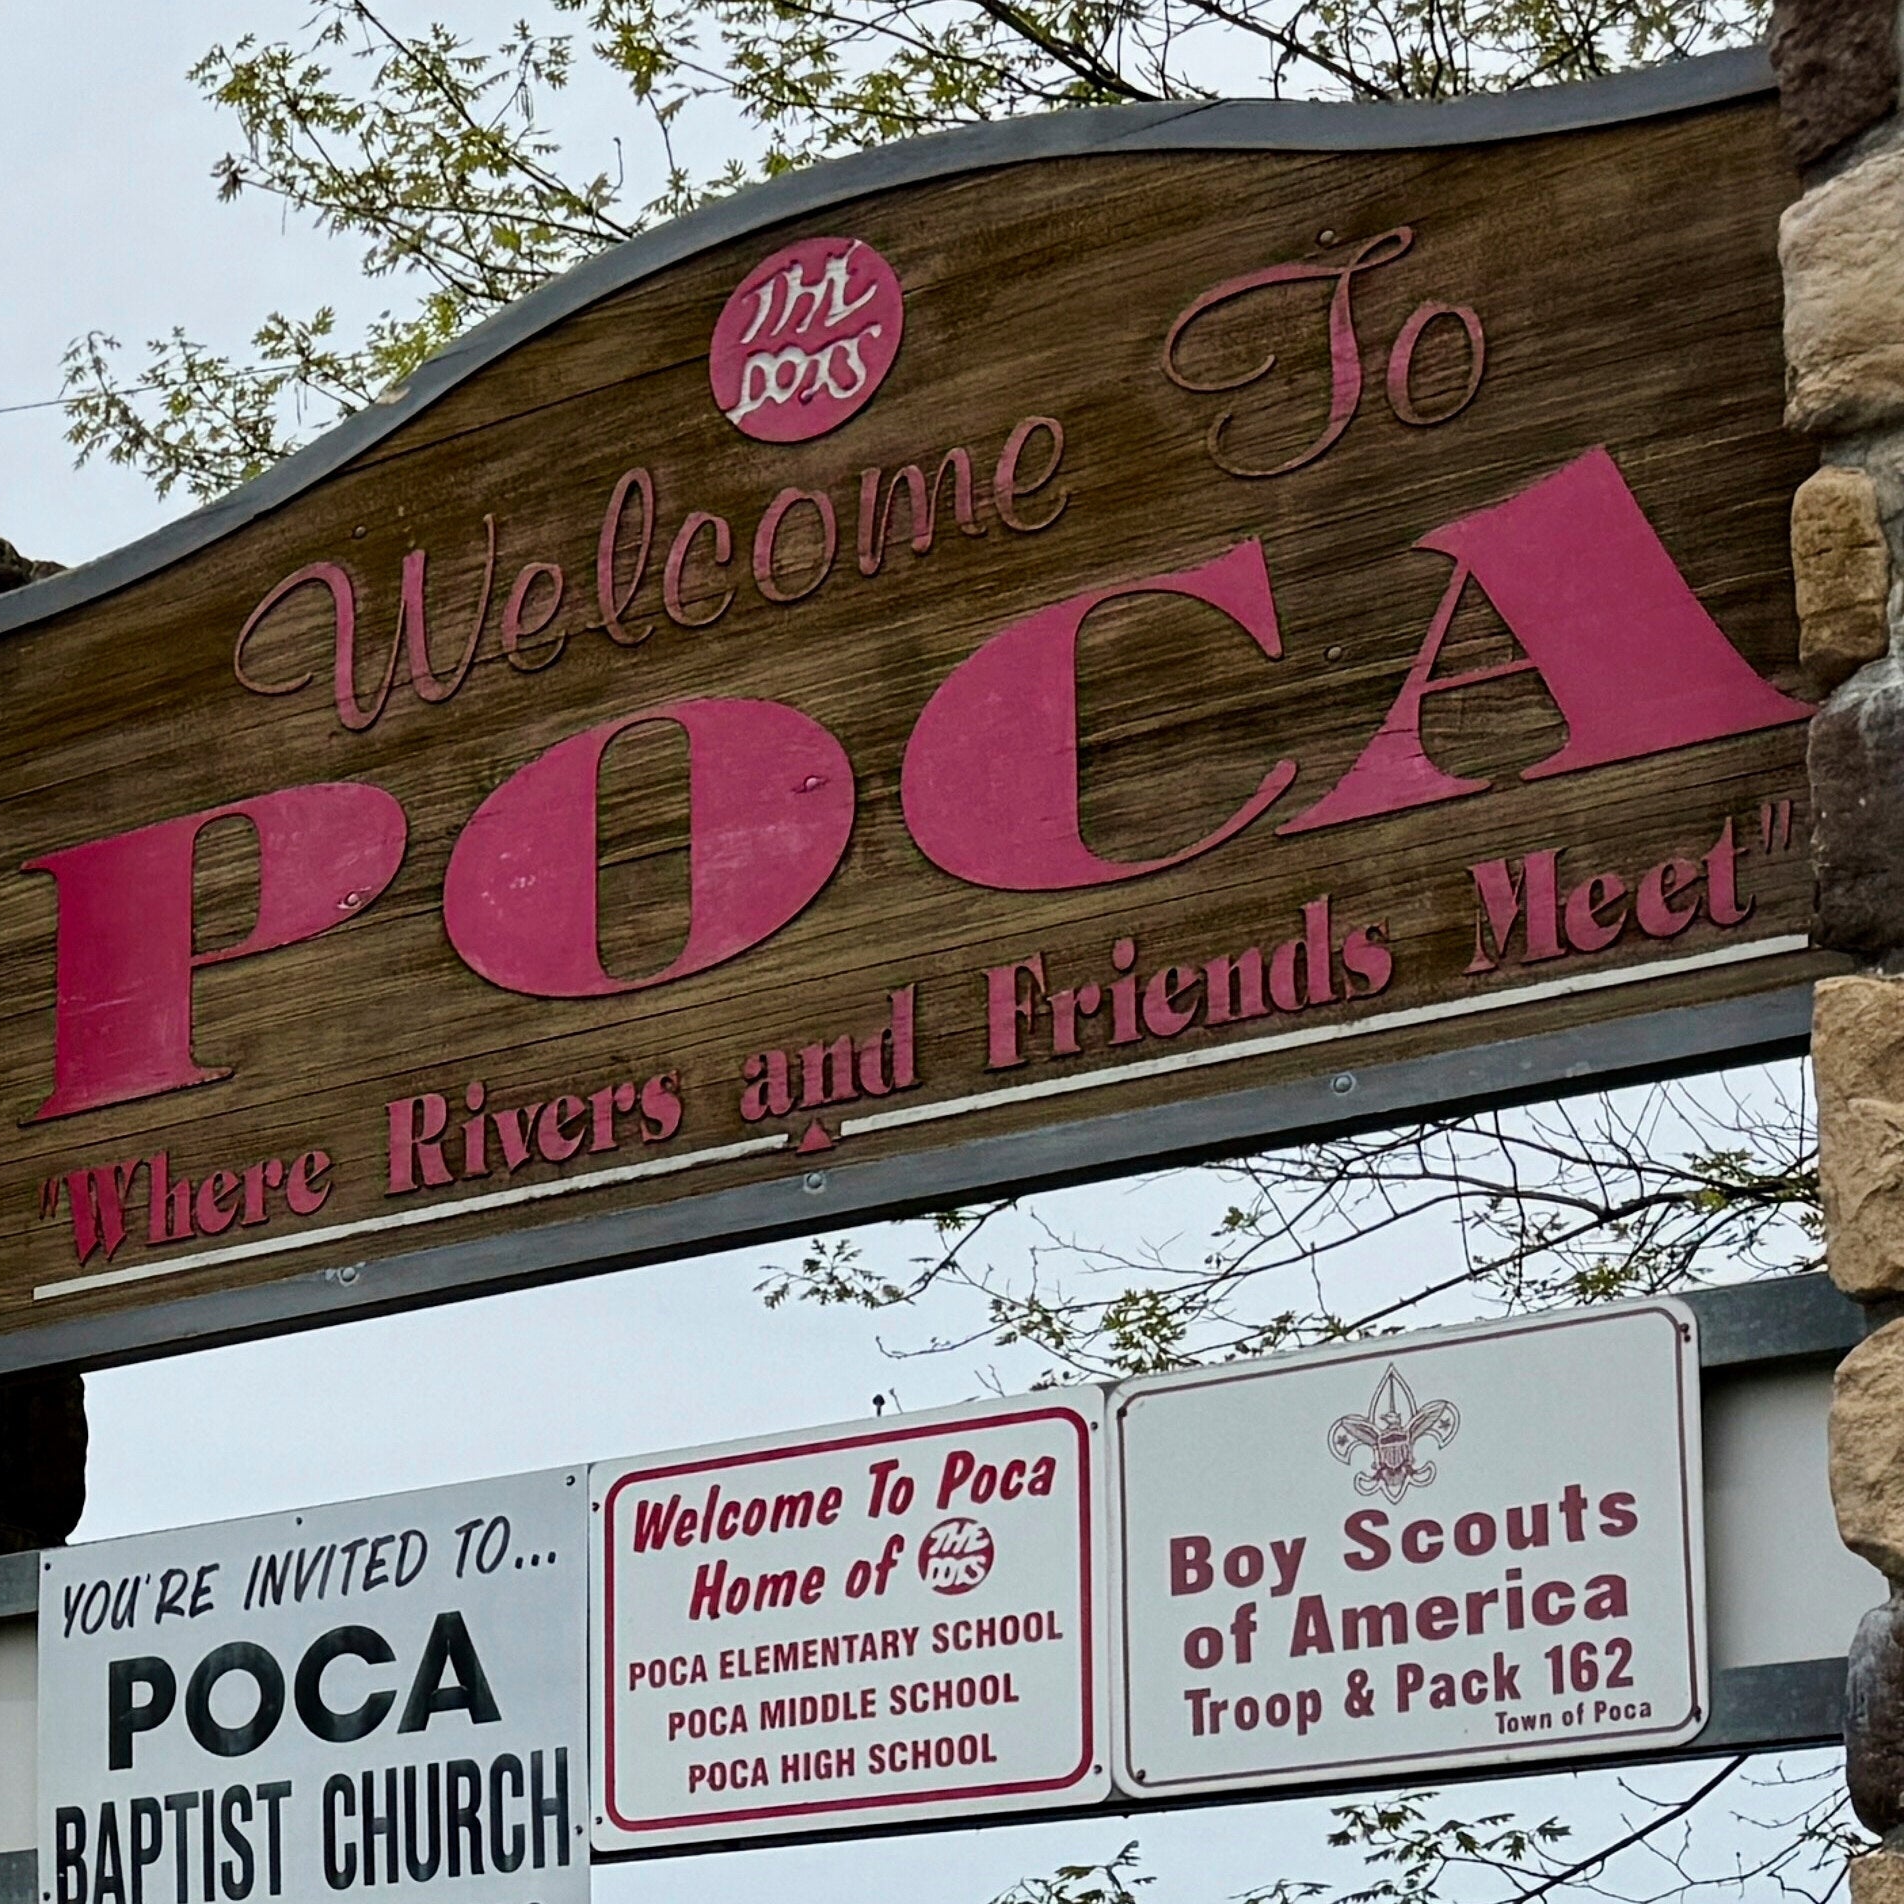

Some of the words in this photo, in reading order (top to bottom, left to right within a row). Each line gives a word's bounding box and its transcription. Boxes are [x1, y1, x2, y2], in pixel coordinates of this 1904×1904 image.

[234, 415, 1071, 730] Welcome
[1161, 226, 1486, 479] To
[18, 443, 1816, 1127] POCA
[384, 1070, 682, 1195] Rivers
[741, 984, 922, 1123] and
[985, 894, 1393, 1071] Friends
[634, 1484, 842, 1553] Welcome
[868, 1459, 914, 1518] To
[937, 1450, 1056, 1510] Poca
[1170, 1536, 1306, 1597] Boy
[1344, 1482, 1638, 1571] Scouts
[64, 1564, 219, 1638] YOU'RE
[244, 1530, 427, 1610] INVITED
[455, 1516, 556, 1578] TO...
[689, 1559, 825, 1620] Home
[846, 1534, 904, 1598] of
[1184, 1602, 1257, 1669] of
[1289, 1568, 1628, 1658] America
[108, 1610, 502, 1770] POCA
[630, 1655, 707, 1691] POCA
[720, 1627, 919, 1679] ELEMENTARY
[933, 1611, 1063, 1653] SCHOOL
[1184, 1688, 1321, 1736] Troop
[1344, 1669, 1374, 1718] &
[1397, 1652, 1521, 1713] Pack
[1545, 1637, 1633, 1695] 162
[669, 1704, 747, 1741] POCA
[761, 1688, 876, 1730] MIDDLE
[890, 1673, 1019, 1715] SCHOOL
[1495, 1712, 1551, 1734] Town
[1562, 1702, 1584, 1726] of
[1595, 1701, 1651, 1723] Poca
[689, 1758, 769, 1793] POCA
[781, 1748, 854, 1783] HIGH
[869, 1733, 997, 1774] SCHOOL
[323, 1747, 569, 1890] CHURCH
